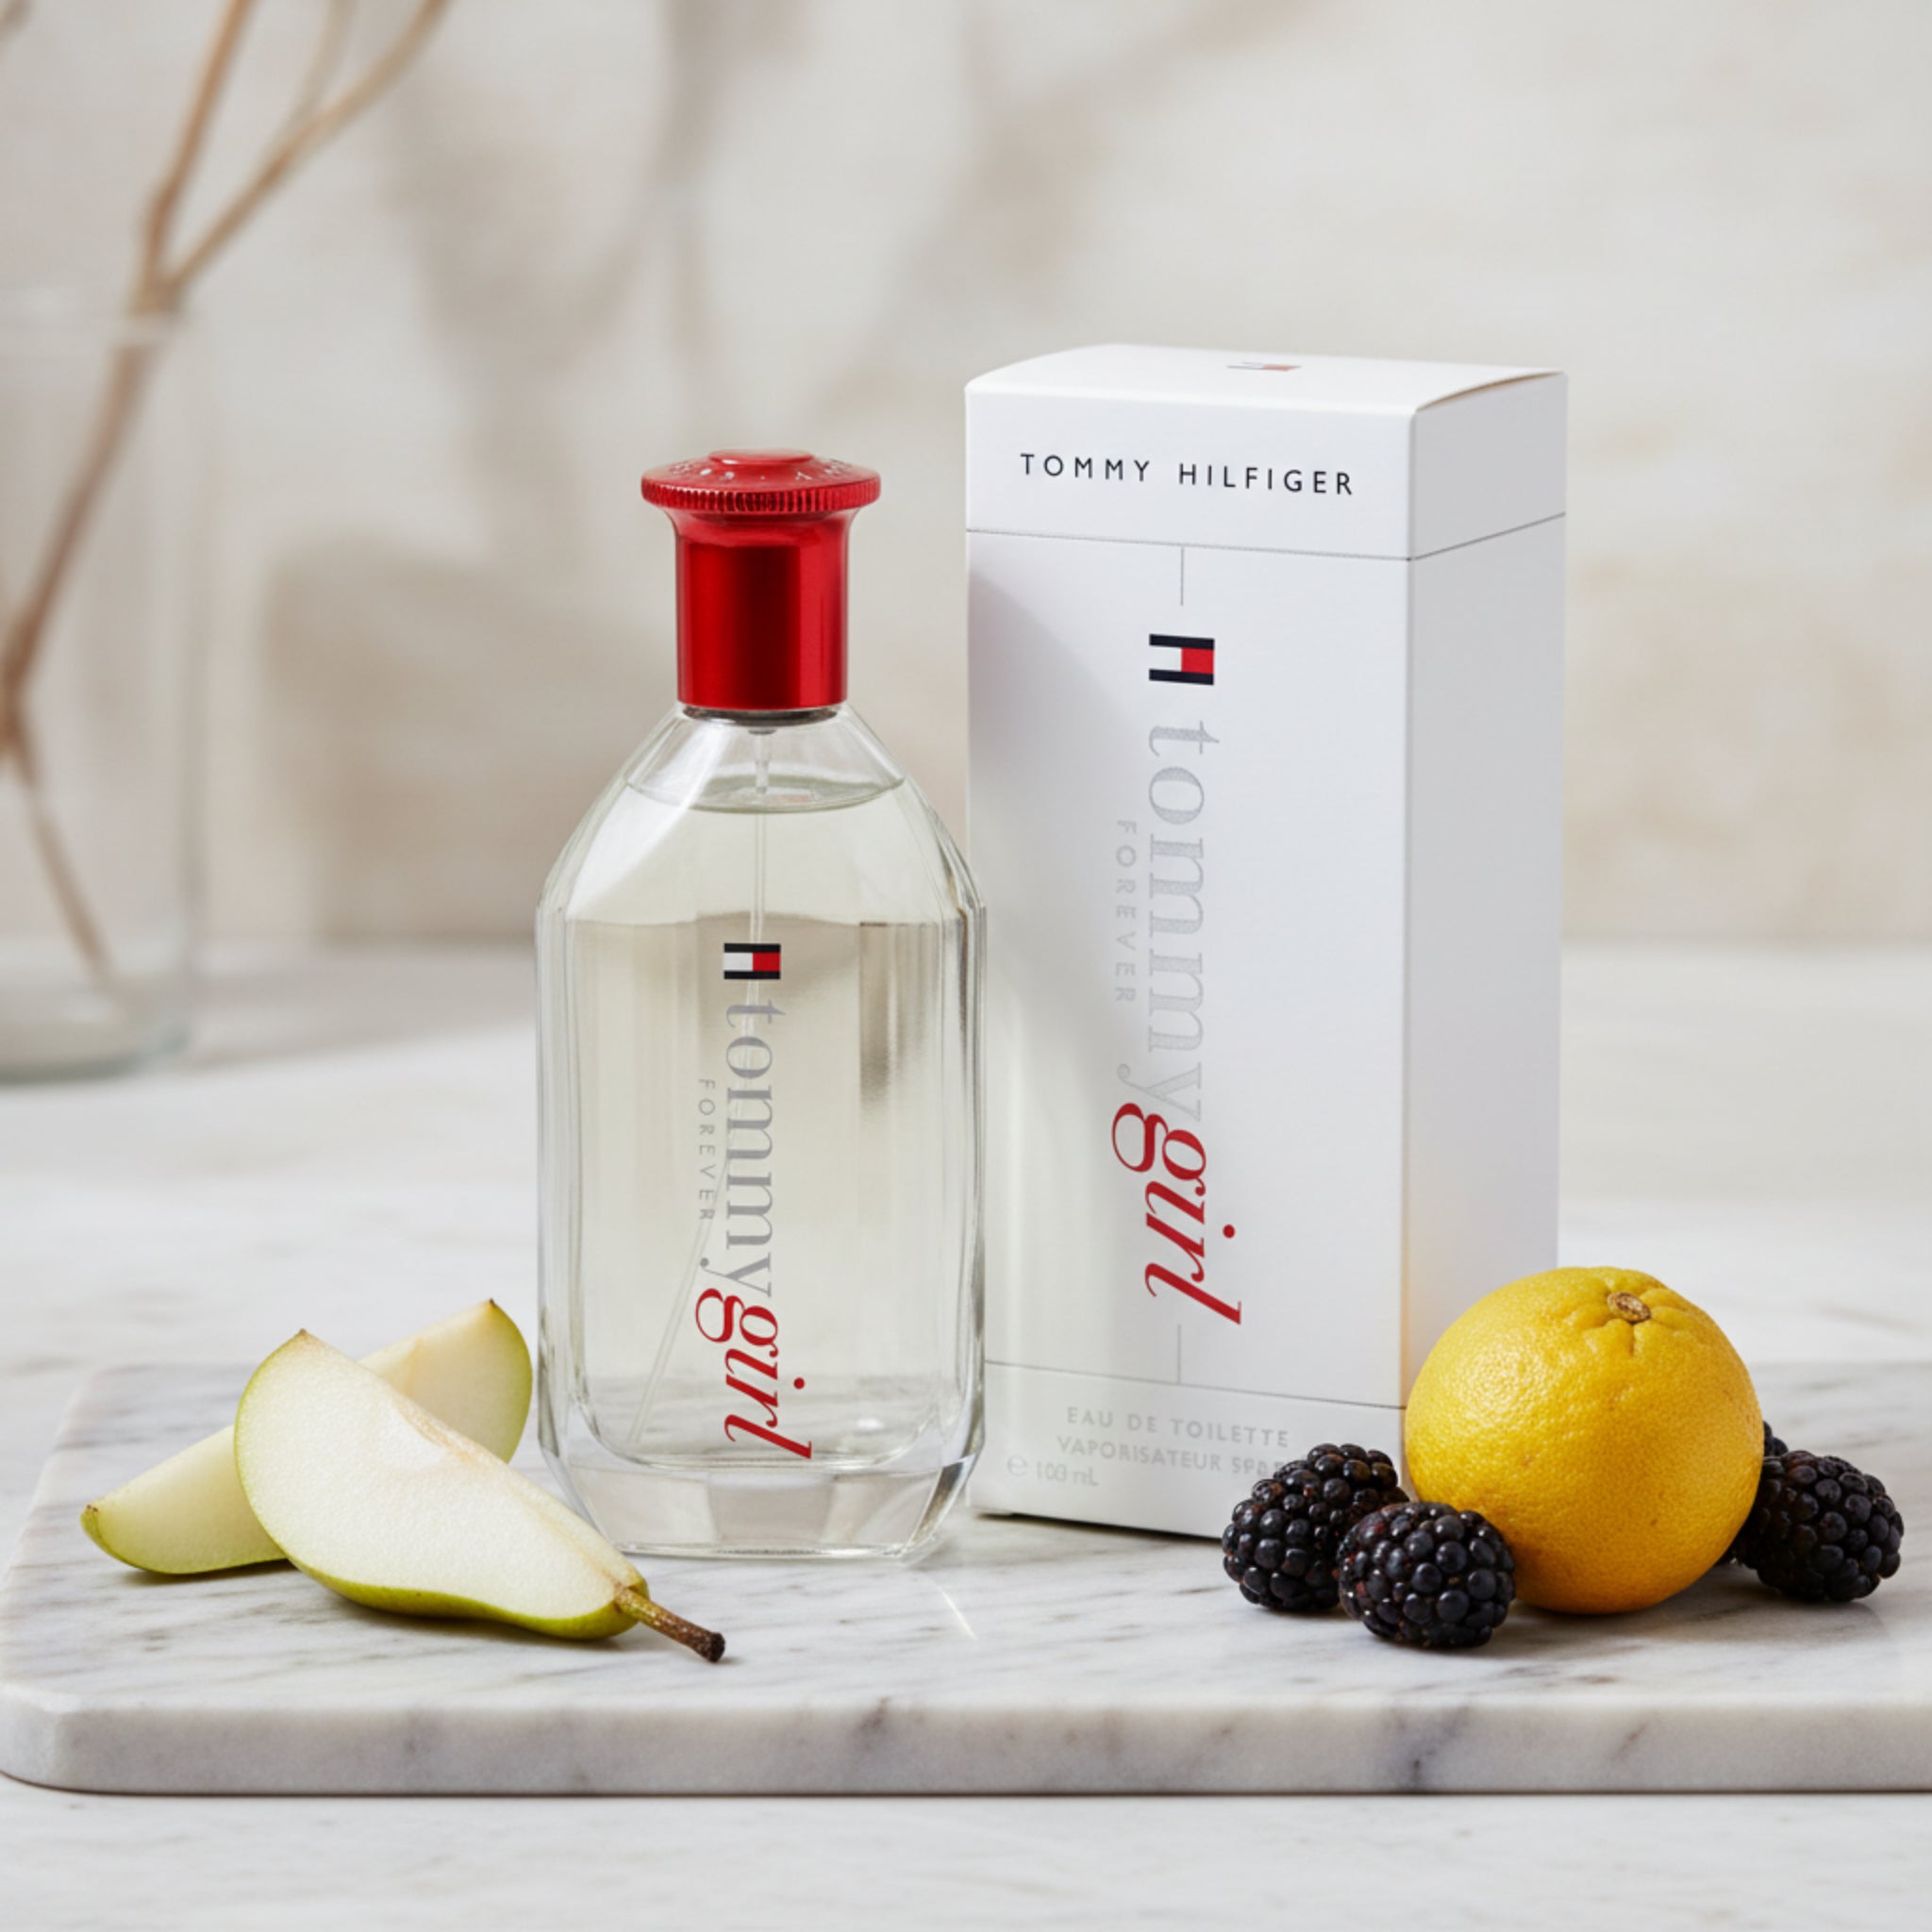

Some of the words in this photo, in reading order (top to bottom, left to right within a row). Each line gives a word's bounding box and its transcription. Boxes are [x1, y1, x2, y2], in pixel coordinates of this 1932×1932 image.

[1020, 453, 1150, 482] TOMMY
[1179, 463, 1353, 495] HILFIGER
[1115, 820, 1137, 1002] FOREVER
[698, 1078, 716, 1221] FOREVER
[1067, 1407, 1113, 1428] EAU
[1126, 1412, 1158, 1434] DE
[1168, 1418, 1289, 1448] TOILETTE
[1058, 1436, 1222, 1471] VAPORISATEUR
